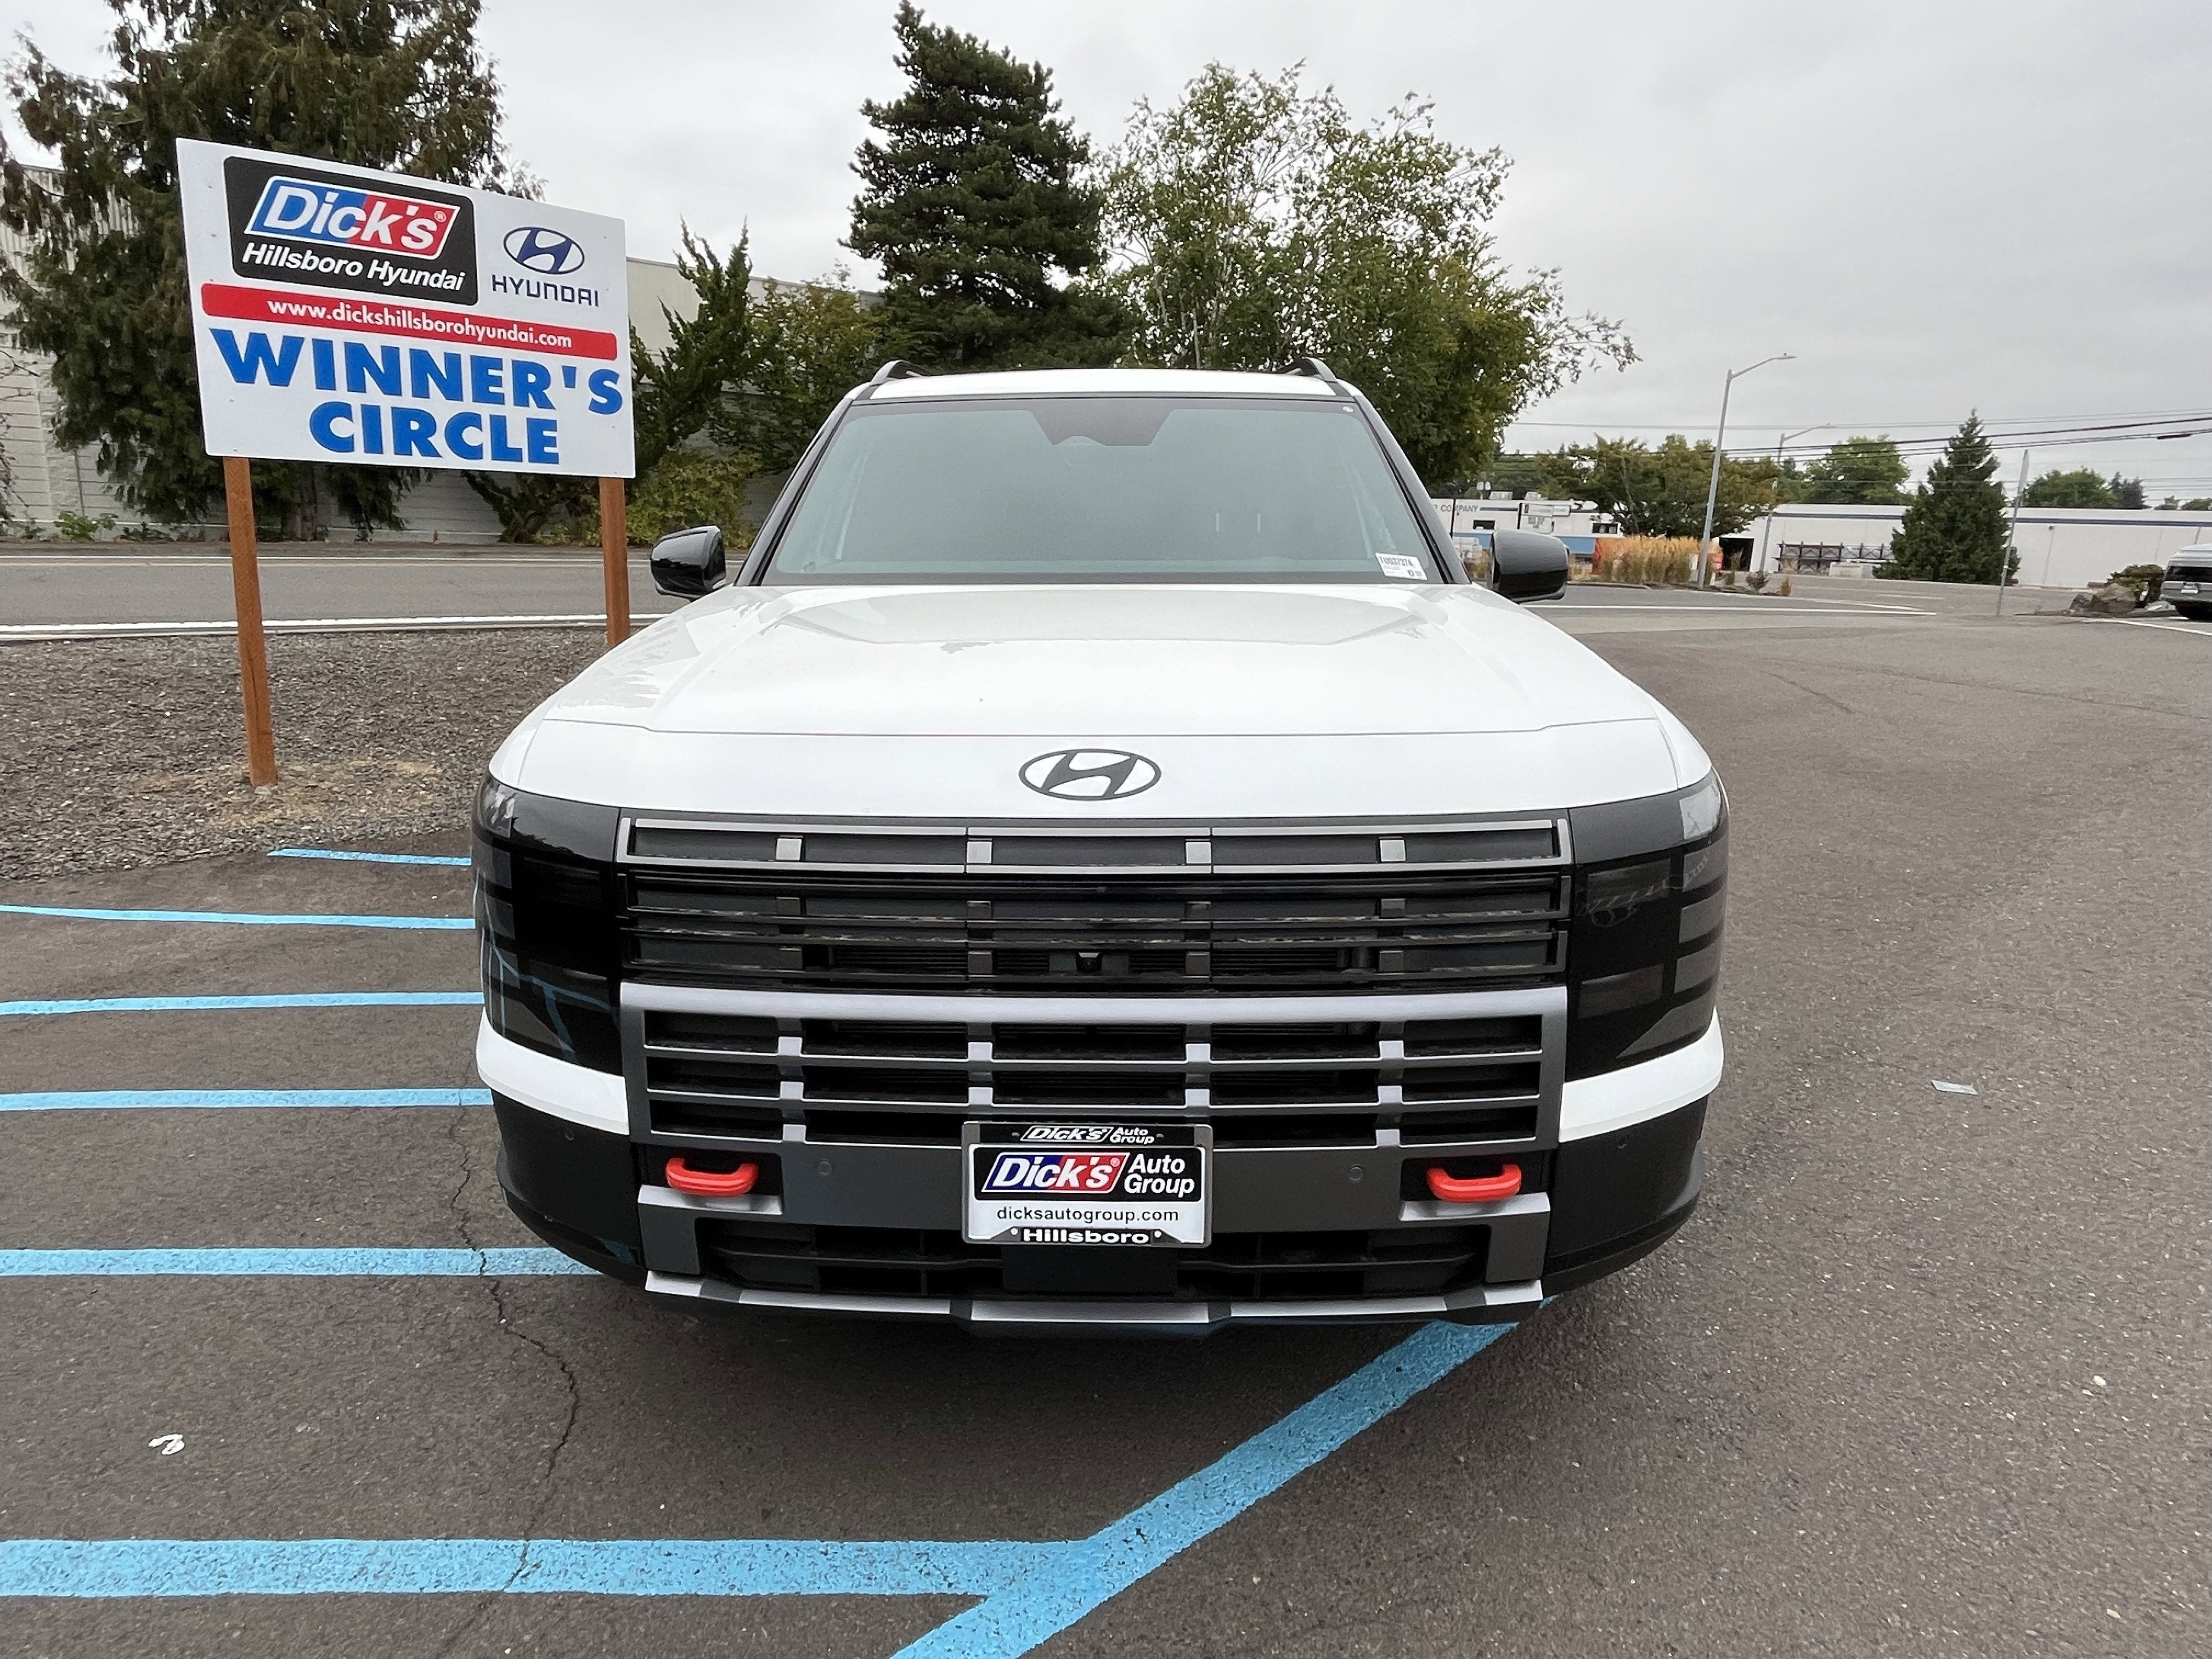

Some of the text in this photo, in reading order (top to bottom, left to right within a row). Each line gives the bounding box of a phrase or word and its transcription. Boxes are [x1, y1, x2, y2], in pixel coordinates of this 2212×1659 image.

[263, 183, 438, 251] Dick's
[242, 242, 465, 292] Hillsboro Hyundai
[492, 274, 600, 307] HYUNDAI
[267, 297, 573, 349] www.dickshillsborohyundai.com
[209, 328, 623, 415] WINNER'S
[309, 401, 560, 465] CIRCLE
[1026, 1127, 1104, 1141] Dick's
[1109, 1135, 1154, 1144] Group
[1112, 1127, 1149, 1136] Auto
[992, 1156, 1113, 1188] Dick's
[1128, 1153, 1186, 1174] Auto
[1124, 1173, 1195, 1198] Group
[997, 1206, 1179, 1224] dicksautogroup.com
[1023, 1228, 1149, 1244] Hillsboro
